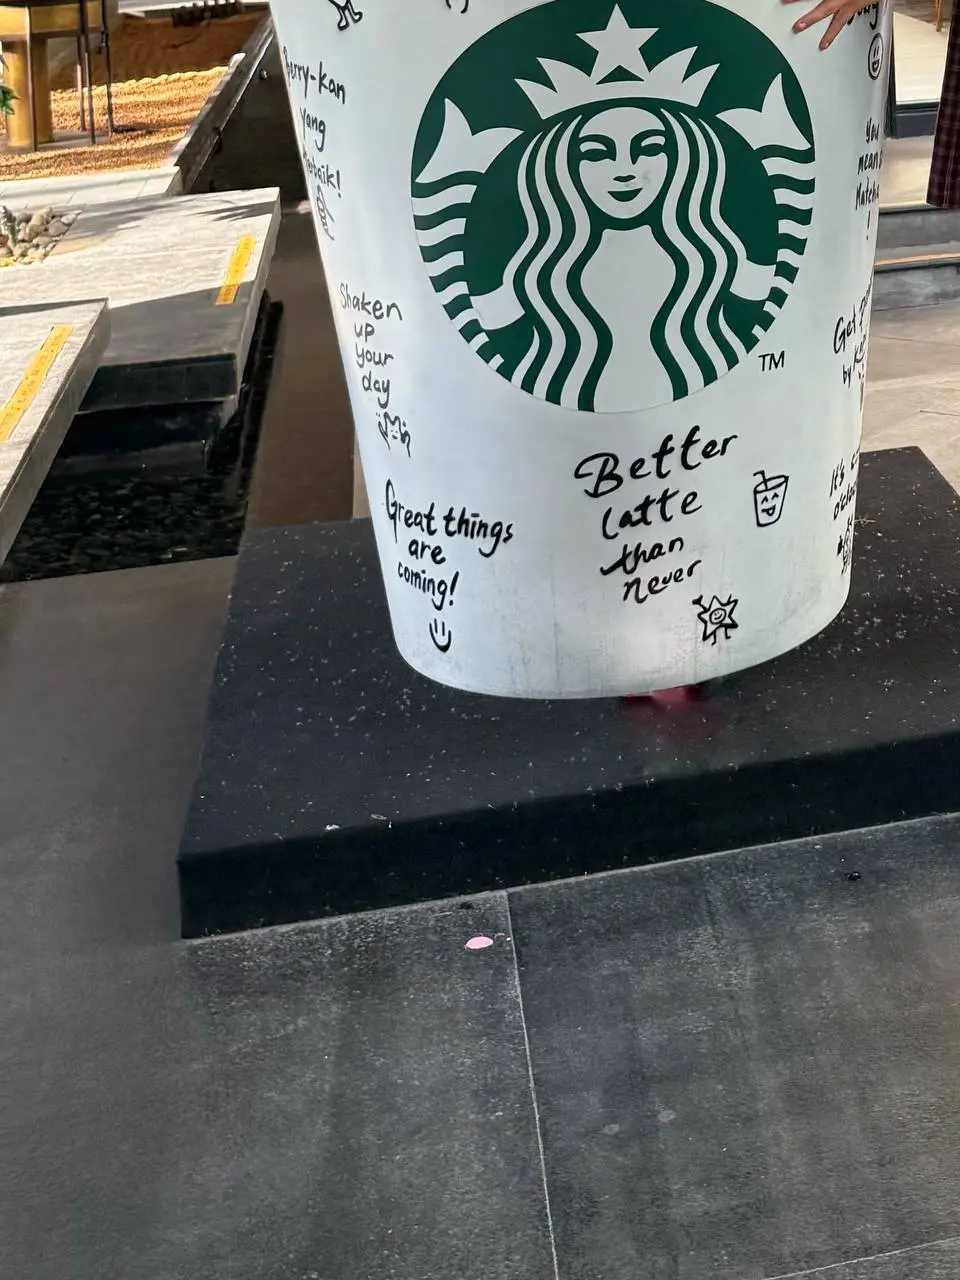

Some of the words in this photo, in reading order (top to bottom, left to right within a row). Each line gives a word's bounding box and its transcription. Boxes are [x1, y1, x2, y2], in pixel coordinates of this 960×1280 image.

[339, 282, 403, 321] Shaken
[353, 322, 375, 348] up
[833, 304, 856, 354] Get
[355, 341, 394, 367] your
[758, 350, 785, 372] TM
[362, 373, 391, 409] day
[842, 364, 852, 388] by
[573, 425, 738, 498] Better
[385, 479, 436, 544] Great
[442, 505, 514, 558] things
[408, 538, 447, 565] are
[600, 536, 684, 575] than
[397, 561, 460, 611] coming!
